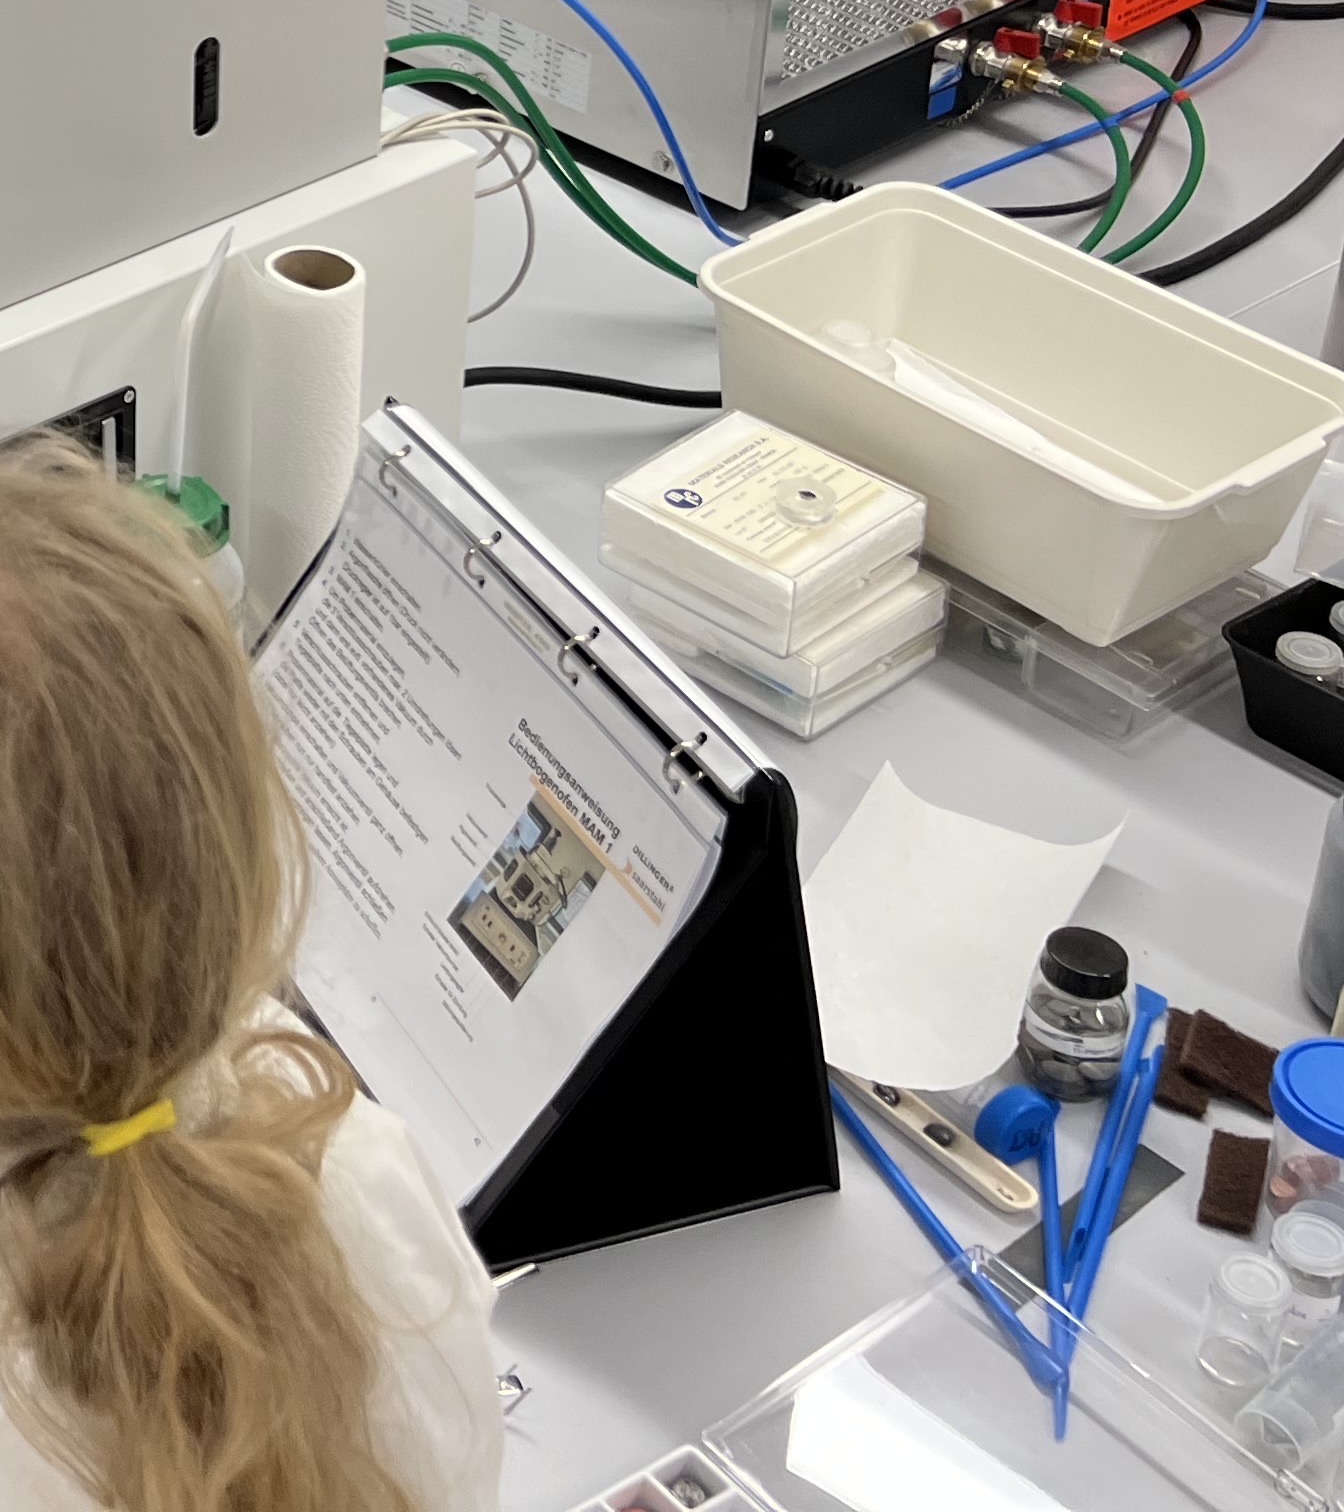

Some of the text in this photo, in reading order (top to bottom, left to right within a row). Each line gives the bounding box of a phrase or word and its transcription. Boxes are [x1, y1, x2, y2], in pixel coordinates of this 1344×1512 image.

[507, 732, 614, 854] Lichtbogenofen MAM 1
[515, 717, 621, 840] Bedienungsanweisung
[629, 870, 666, 913] saarstahl
